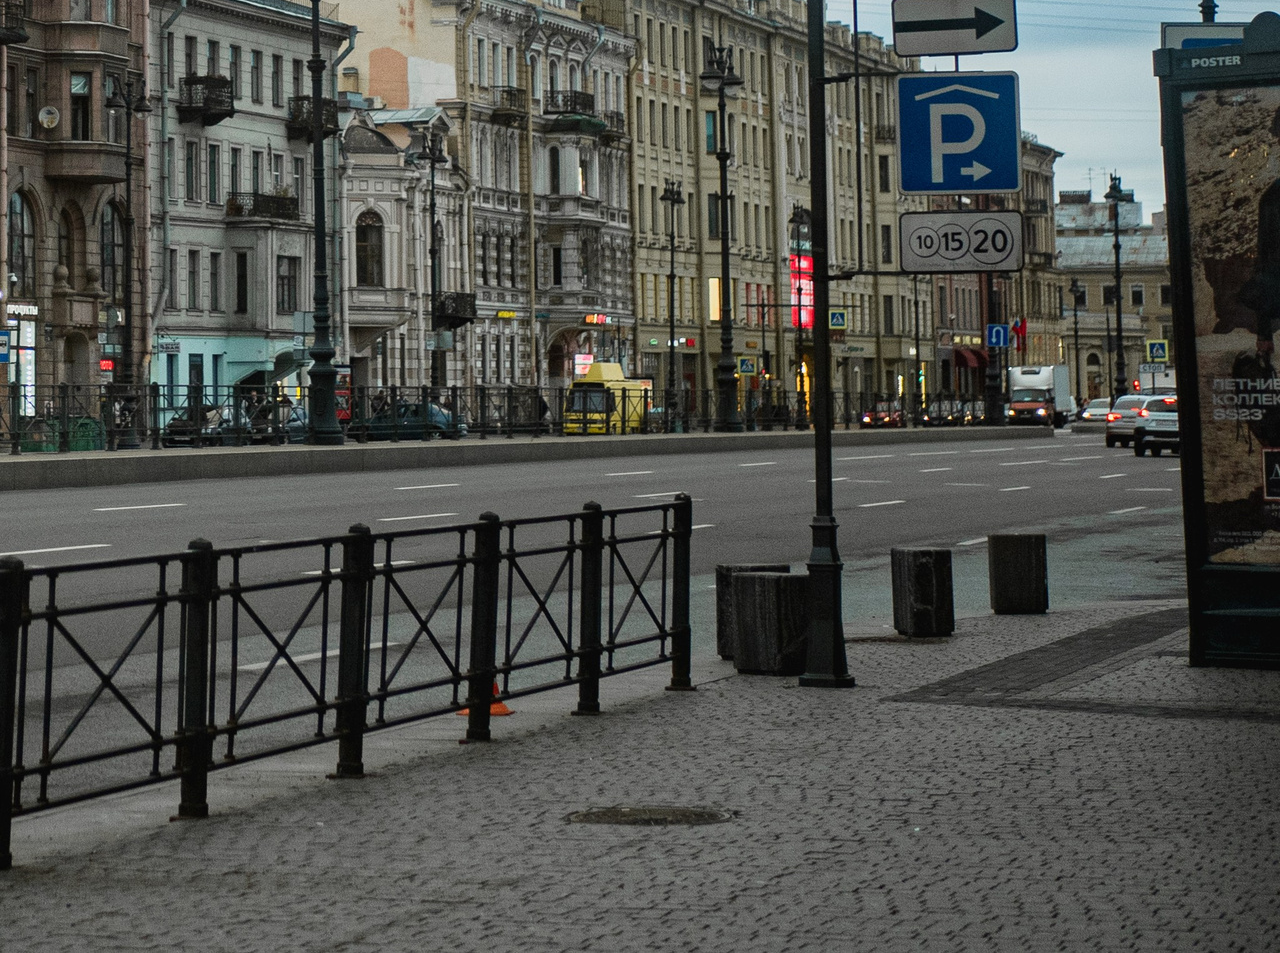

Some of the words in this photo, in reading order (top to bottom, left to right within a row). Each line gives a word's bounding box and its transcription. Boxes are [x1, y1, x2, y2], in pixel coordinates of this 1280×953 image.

[1191, 55, 1242, 68] POSTER
[931, 103, 986, 183] P
[916, 234, 934, 250] 10
[941, 231, 964, 251] 15
[973, 229, 1008, 253] 20
